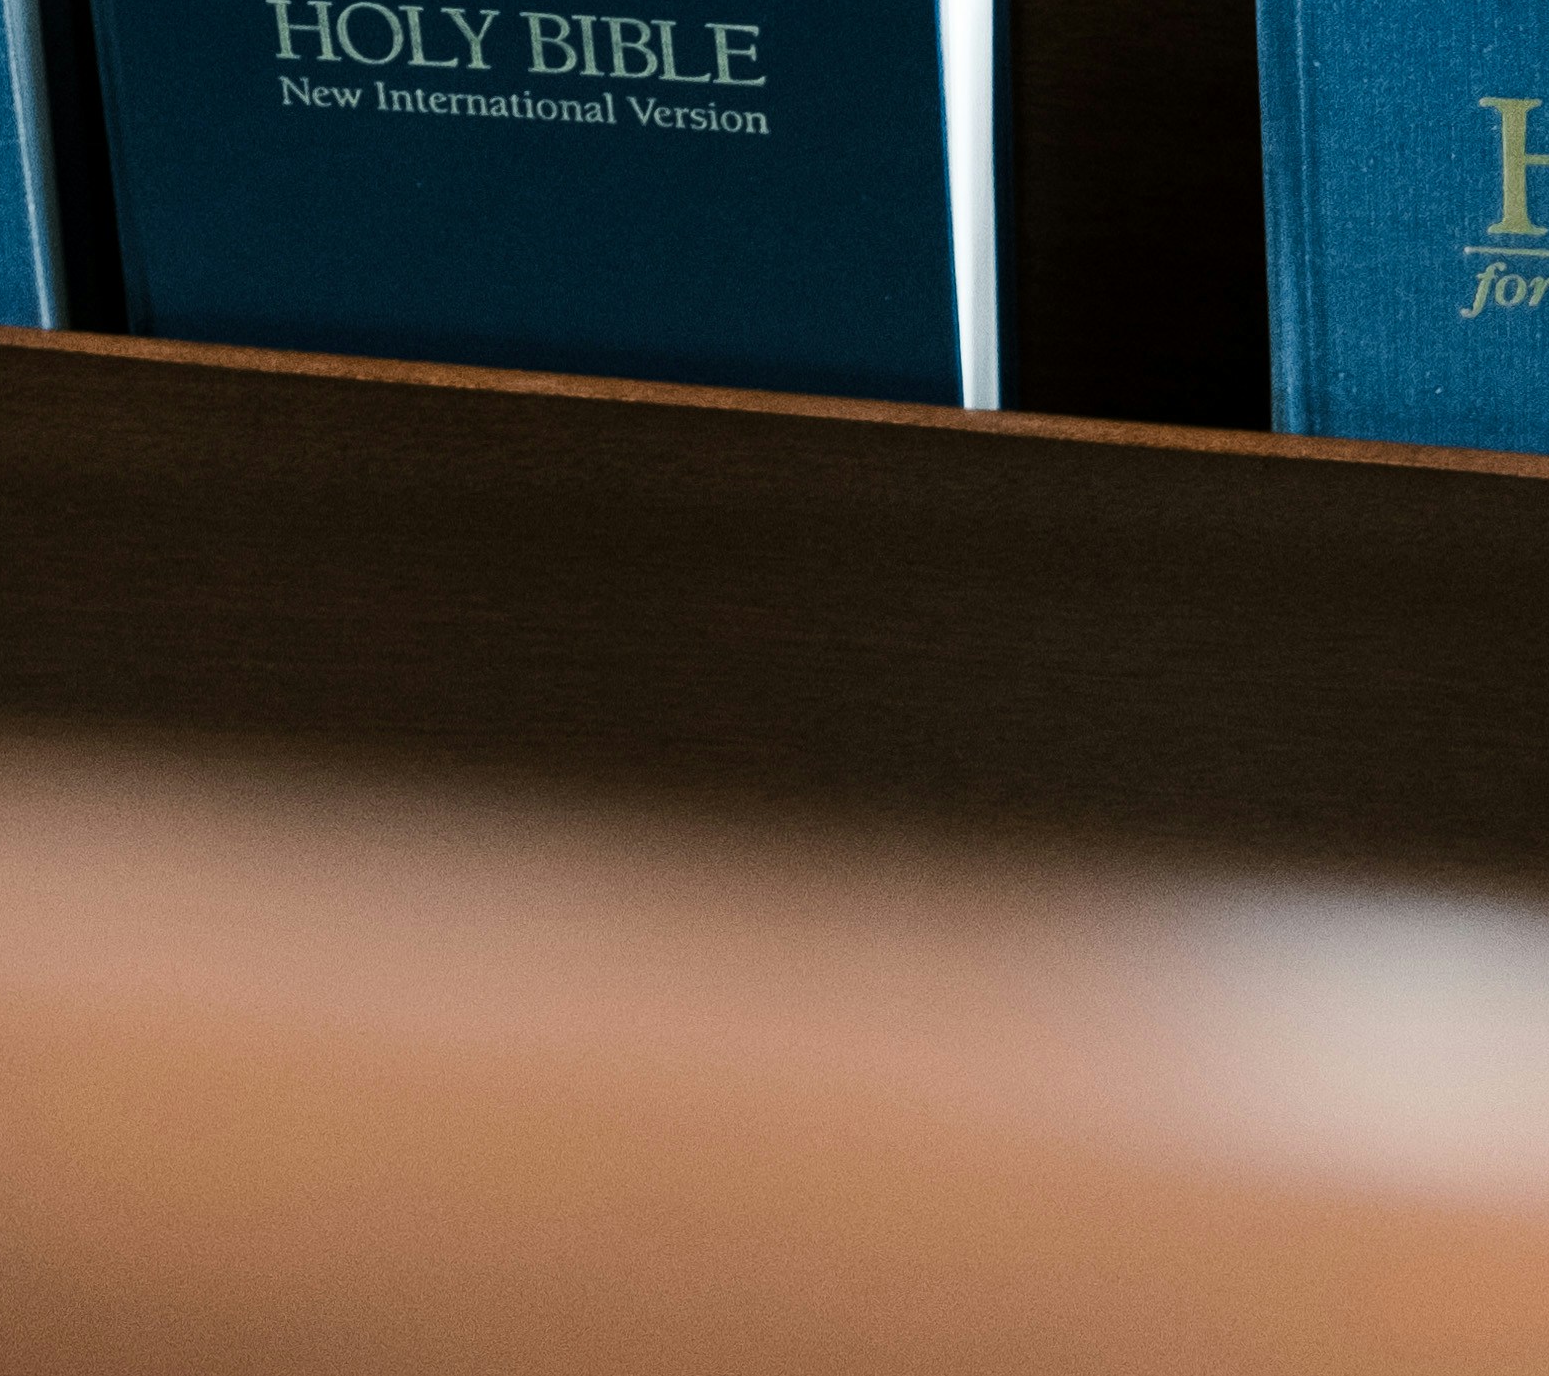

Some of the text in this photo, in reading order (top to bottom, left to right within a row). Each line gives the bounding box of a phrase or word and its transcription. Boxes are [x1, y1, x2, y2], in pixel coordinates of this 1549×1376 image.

[519, 12, 767, 86] BIBLE
[278, 76, 770, 135] New International Version
